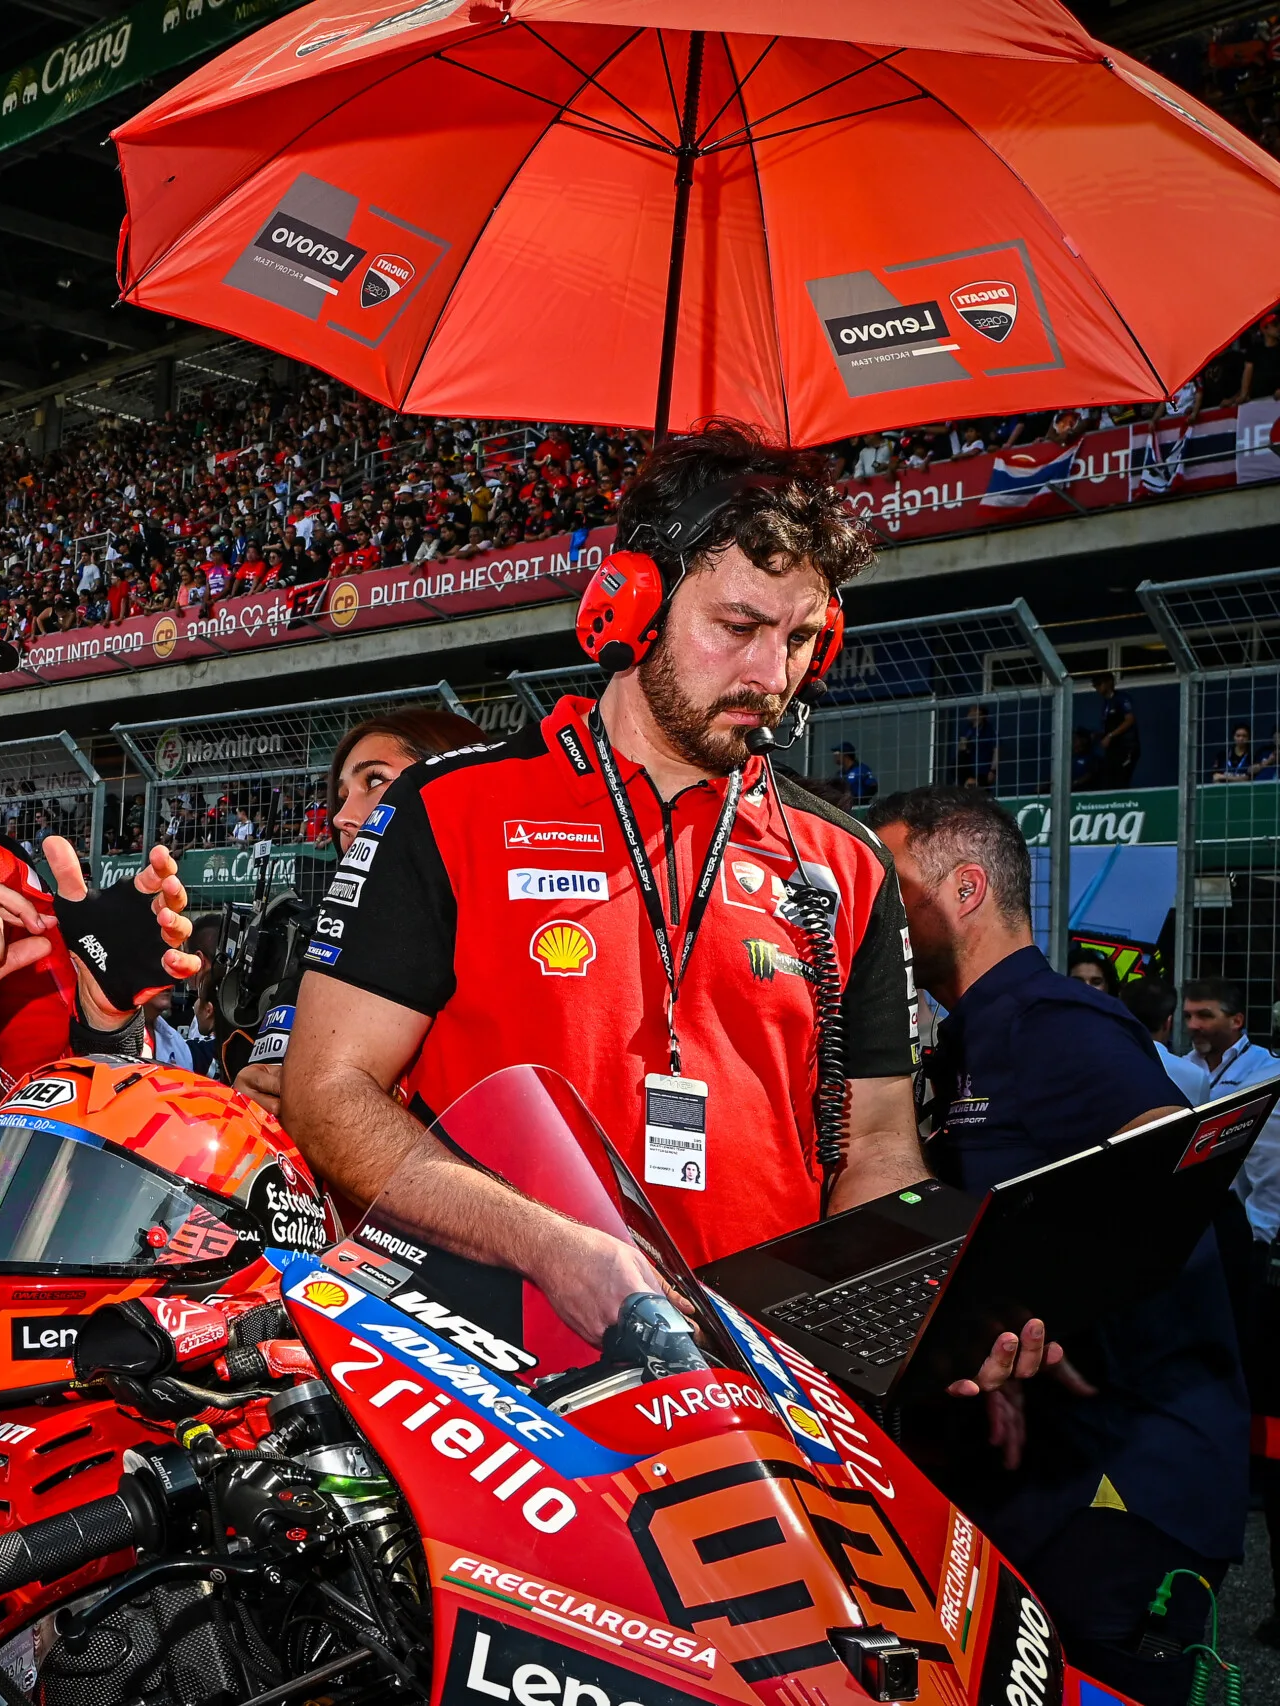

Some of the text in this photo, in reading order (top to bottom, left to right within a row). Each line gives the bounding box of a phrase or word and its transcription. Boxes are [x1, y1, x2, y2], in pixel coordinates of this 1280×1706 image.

[42, 22, 133, 95] Chang
[334, 594, 355, 613] CP
[370, 581, 410, 608] PUT
[412, 573, 453, 599] OUR
[67, 631, 144, 663] INTO FOOD
[156, 628, 174, 647] CP
[474, 700, 531, 736] ang
[186, 732, 281, 764] Maxnitron
[561, 730, 587, 772] Lenovo
[345, 841, 370, 863] ello
[535, 830, 600, 844] AUTOGRILL
[538, 872, 601, 894] riello
[317, 909, 345, 939] ica
[266, 1009, 287, 1024] TIM
[1220, 1118, 1255, 1139] Lenovo
[265, 1181, 327, 1220] Estrella
[360, 1224, 428, 1265] MARQUEZ
[360, 1263, 396, 1286] Lenovo
[23, 1326, 79, 1350] Len
[387, 1291, 541, 1373] WRS
[358, 1321, 565, 1442] ADVANCE
[150, 1455, 173, 1491] domino
[370, 1380, 577, 1534] riello
[940, 1511, 975, 1642] FRECCIAROSSA
[449, 1557, 718, 1670] FRECCIAROSSA
[1005, 1597, 1051, 1706] enovo
[1005, 1597, 1051, 1706] enovo
